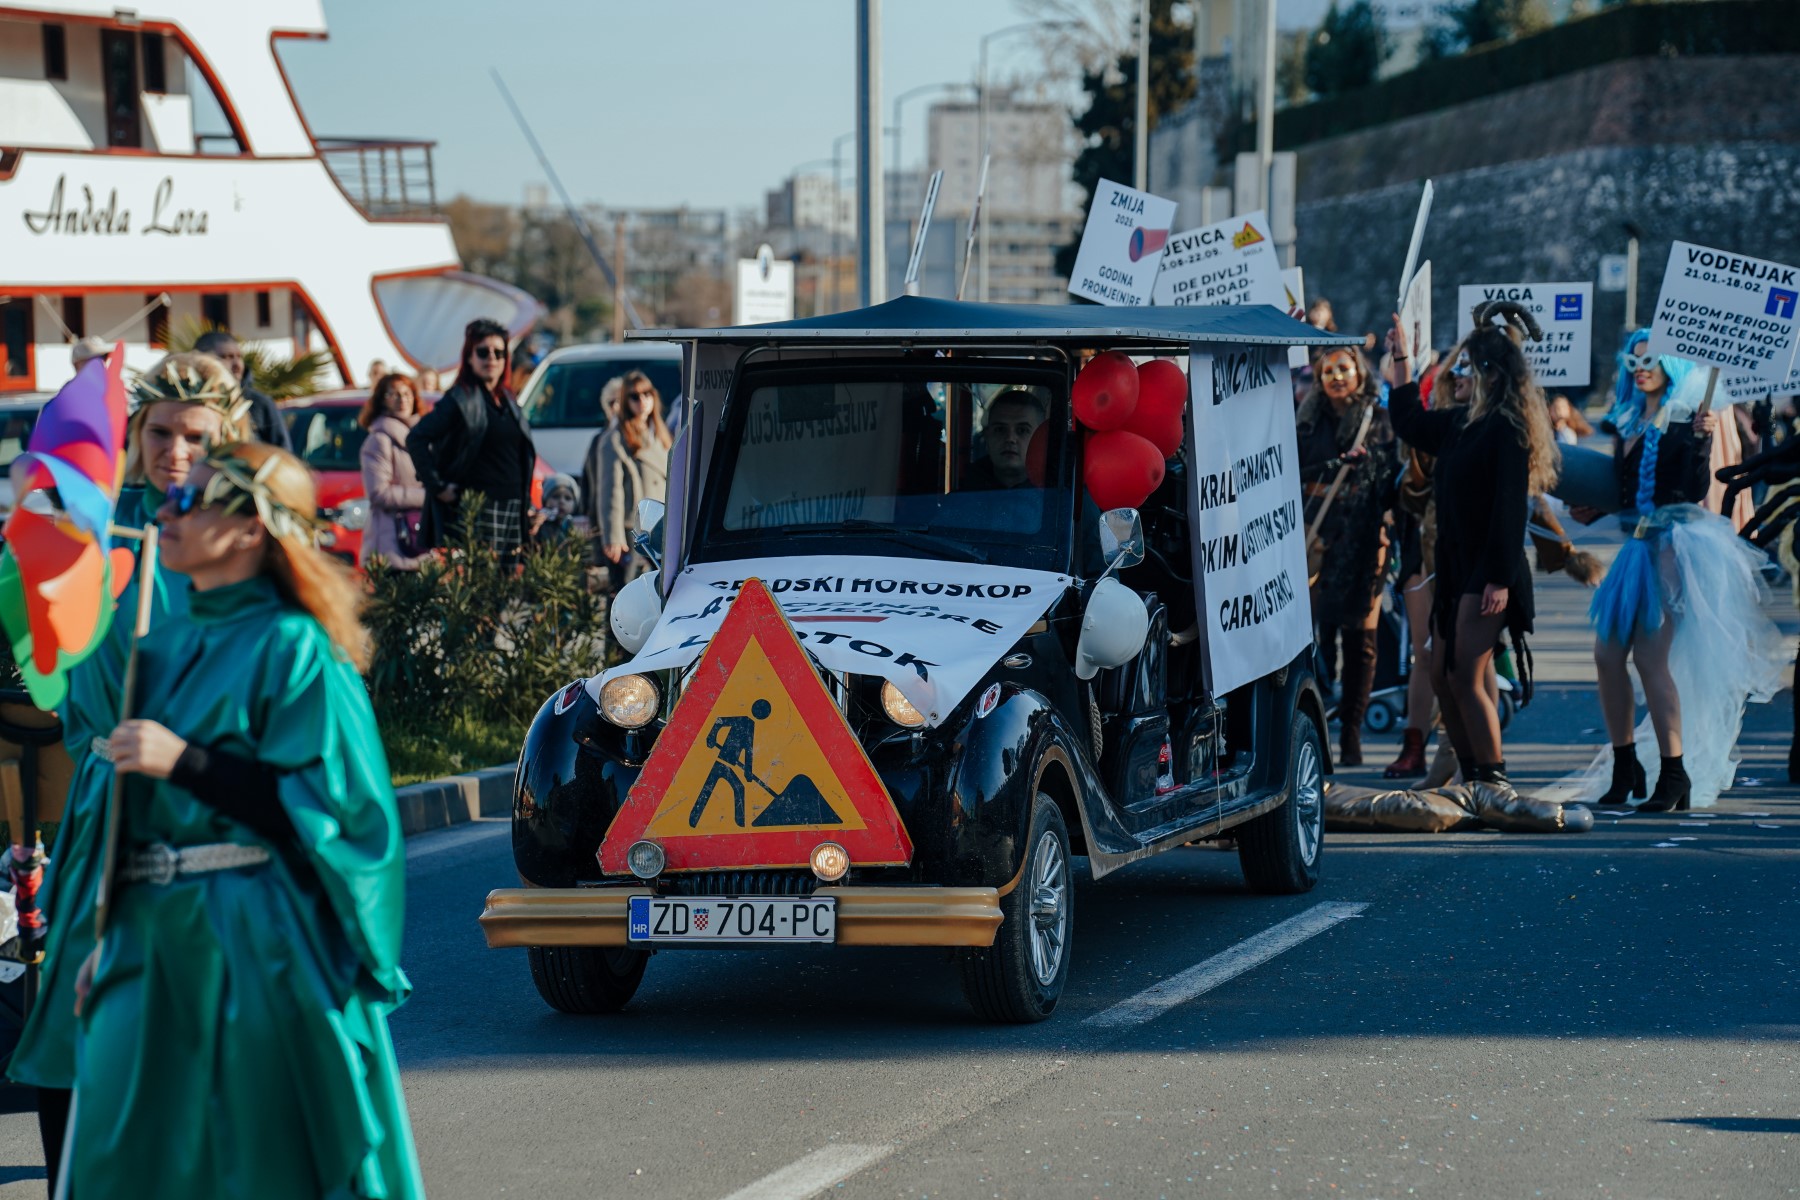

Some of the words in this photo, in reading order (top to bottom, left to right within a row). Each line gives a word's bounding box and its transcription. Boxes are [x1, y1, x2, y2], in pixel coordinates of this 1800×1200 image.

[141, 175, 209, 237] Lora
[1110, 190, 1145, 216] ZMIJA
[1163, 228, 1225, 257] JEVICA
[1098, 265, 1133, 289] GODINA
[1173, 277, 1197, 293] IDE
[1201, 262, 1248, 285] DIVLJI
[1688, 247, 1796, 286] VODENJAK
[1684, 267, 1764, 293] 21.01.-18.02.
[1174, 290, 1202, 306] OFF
[1484, 288, 1533, 301] VAGA
[1659, 311, 1675, 322] NI
[1678, 315, 1706, 330] GPS
[1709, 322, 1748, 340] NEĆE
[1750, 332, 1790, 349] MOĆI
[1665, 298, 1675, 308] U
[1678, 301, 1722, 319] OVOM
[1724, 312, 1792, 336] PERIODU
[1559, 331, 1575, 341] TE
[1667, 326, 1735, 351] LOCIRATI
[1737, 339, 1776, 361] VAŠE
[1676, 342, 1759, 371] ODREDIŠTE
[1533, 368, 1567, 377] TIMA
[708, 576, 844, 593] GRDSKI
[851, 577, 1032, 599] HOROSKOP
[782, 601, 941, 612] ODINA
[632, 923, 648, 934] HR
[653, 903, 690, 935] ZD
[716, 903, 830, 936] 704-PC
